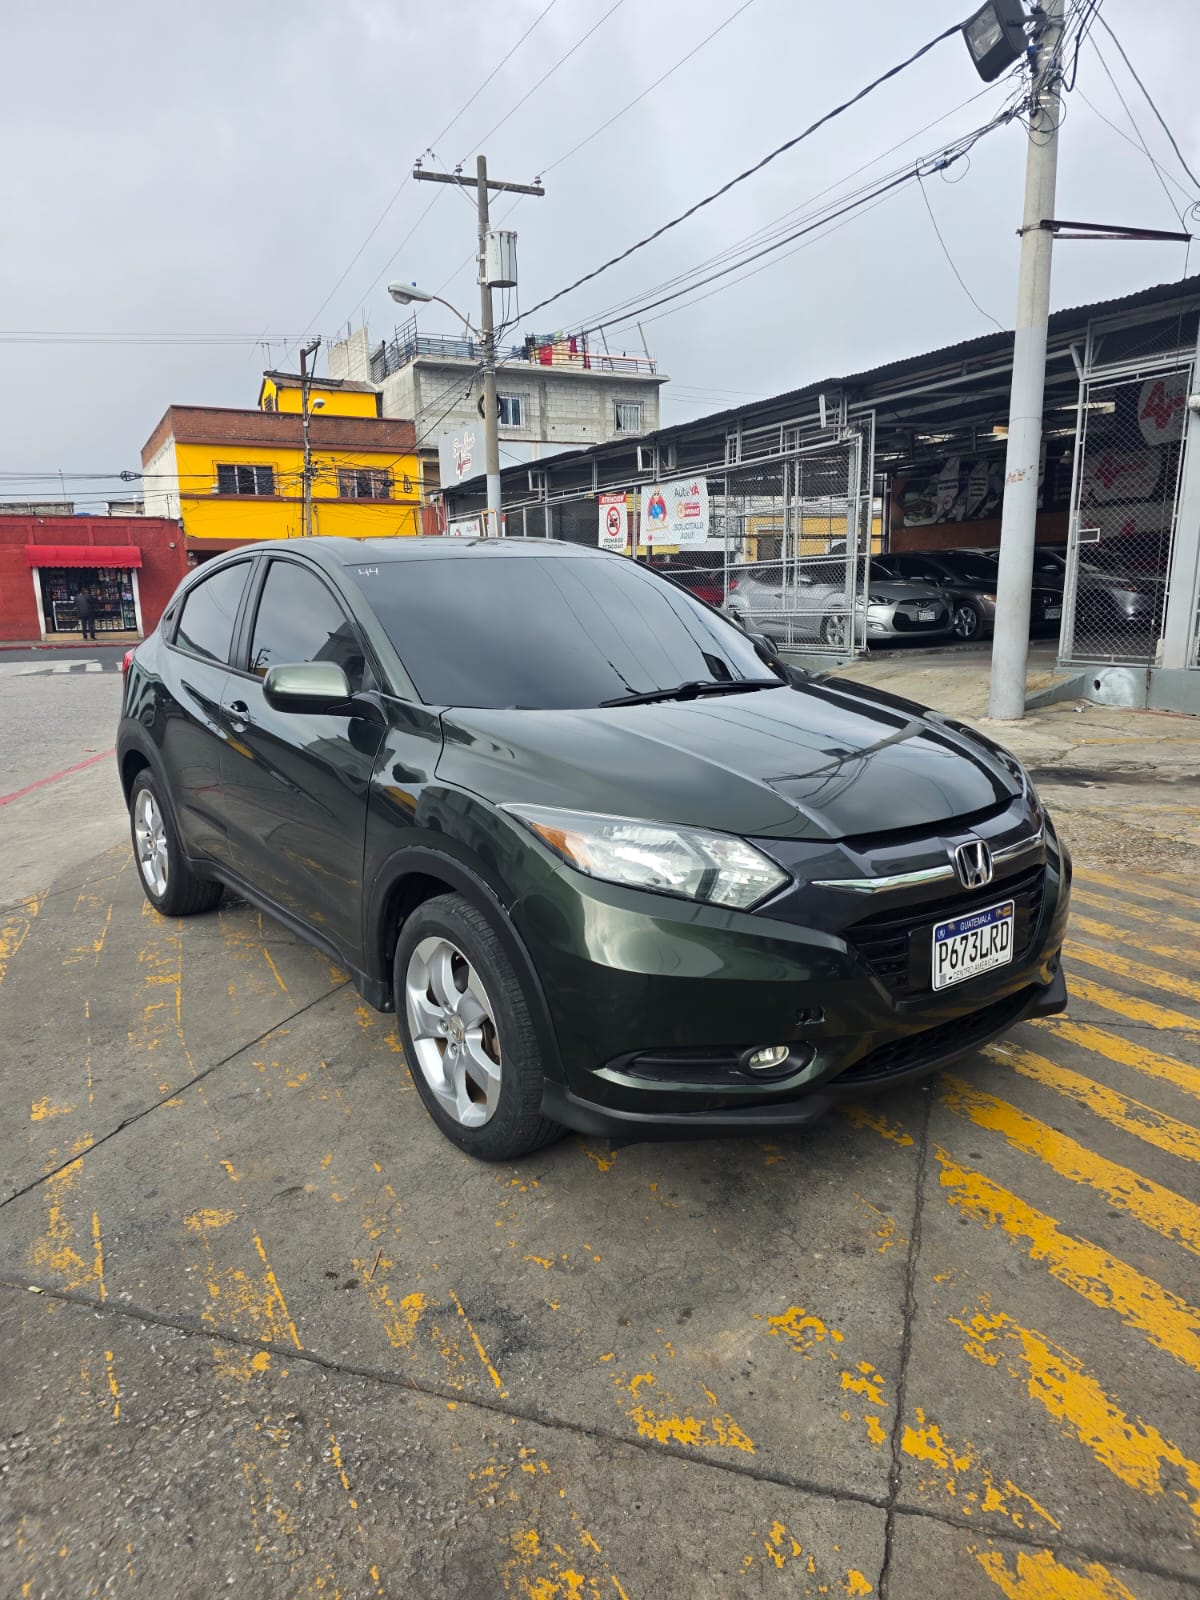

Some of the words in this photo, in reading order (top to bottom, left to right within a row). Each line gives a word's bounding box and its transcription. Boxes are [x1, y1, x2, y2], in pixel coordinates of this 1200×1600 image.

[358, 567, 378, 577] 44
[960, 914, 991, 931] GUATEMALA
[939, 921, 1009, 974] P673LRD
[953, 964, 974, 980] CENTRO
